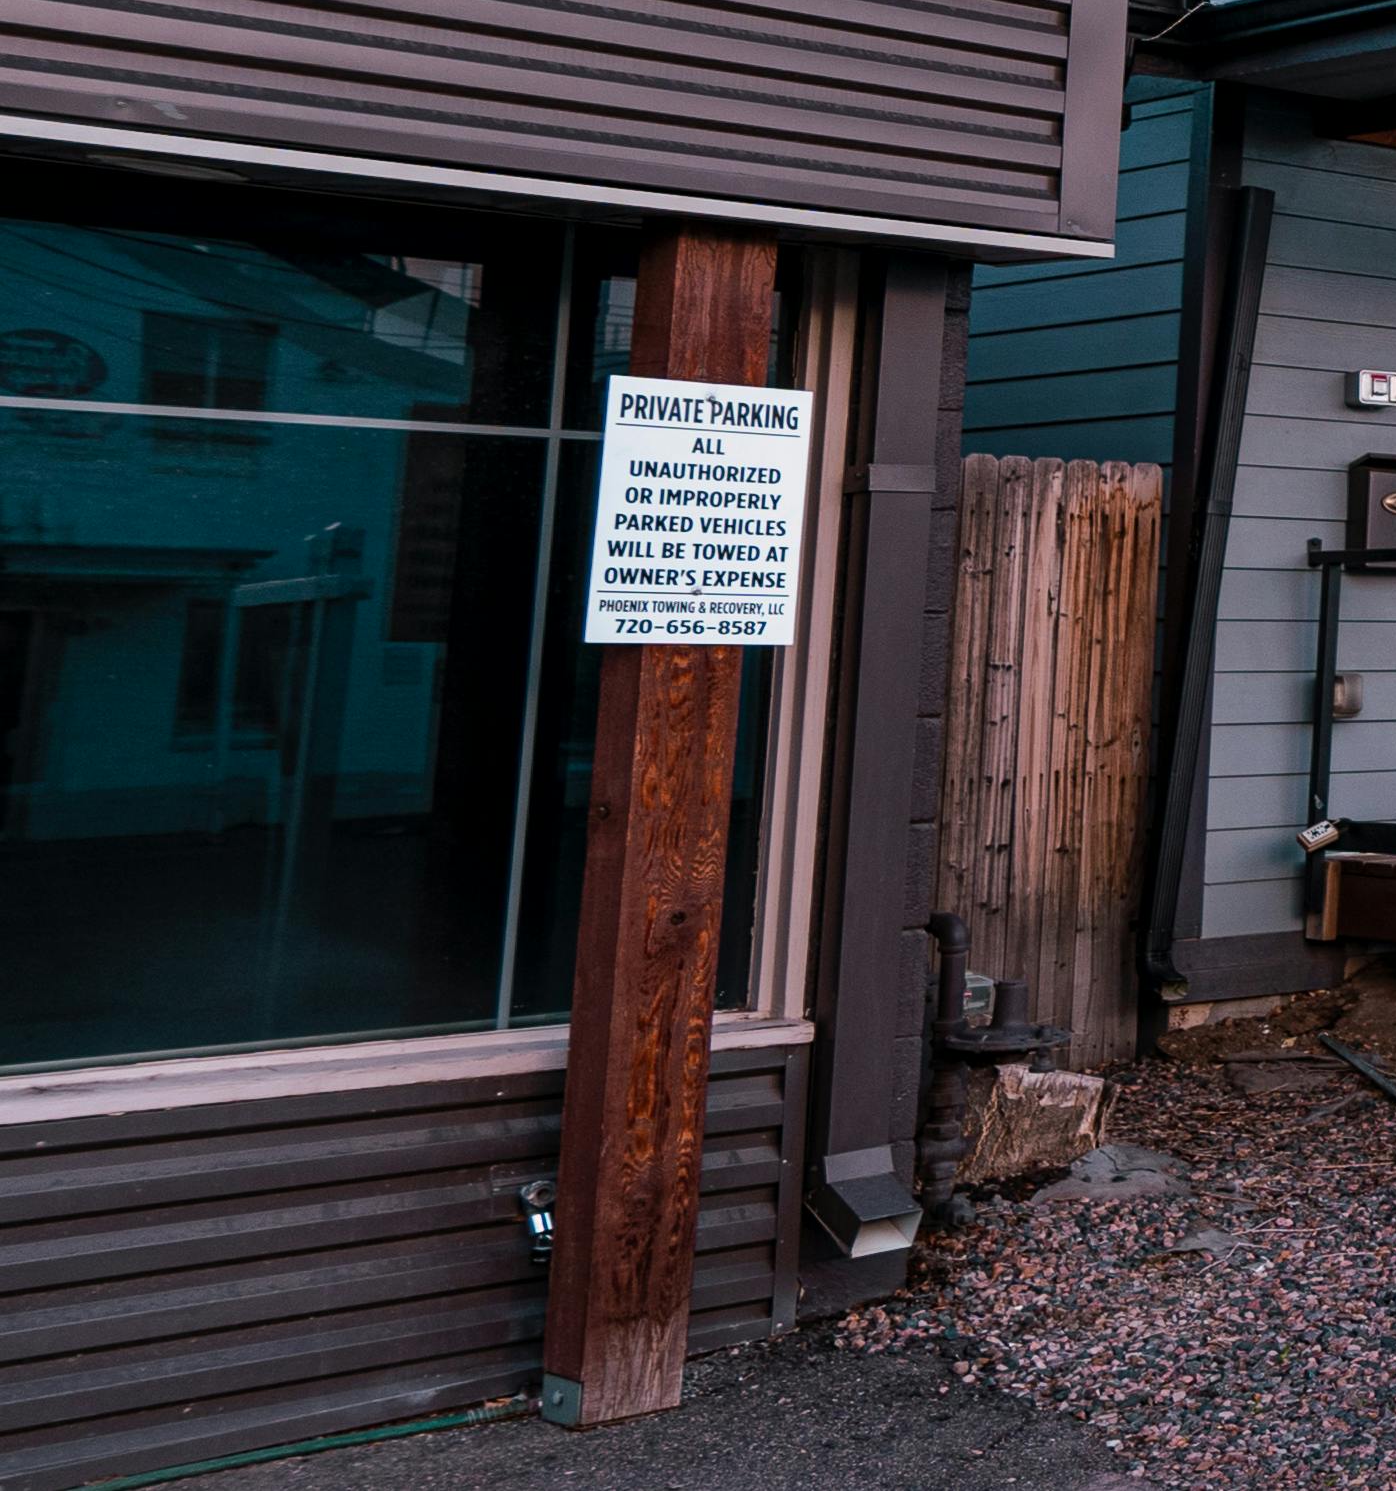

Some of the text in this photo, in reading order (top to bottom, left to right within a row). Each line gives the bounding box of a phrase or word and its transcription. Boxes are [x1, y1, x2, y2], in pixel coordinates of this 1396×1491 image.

[619, 393, 799, 431] PRIVATE PARKING
[691, 437, 725, 455] ALL
[629, 460, 782, 484] UNAUTHORIZED
[625, 487, 782, 511] OR IMPROPERLY
[614, 513, 787, 537] PARKED VEHICLES
[607, 540, 789, 562] WILL BE TOWED AT
[604, 567, 786, 588] OWNER'S EXPENSE
[599, 599, 785, 617] PHOENIX TOWING & RECOVERY, LLC
[615, 618, 767, 636] 720-656-8587
